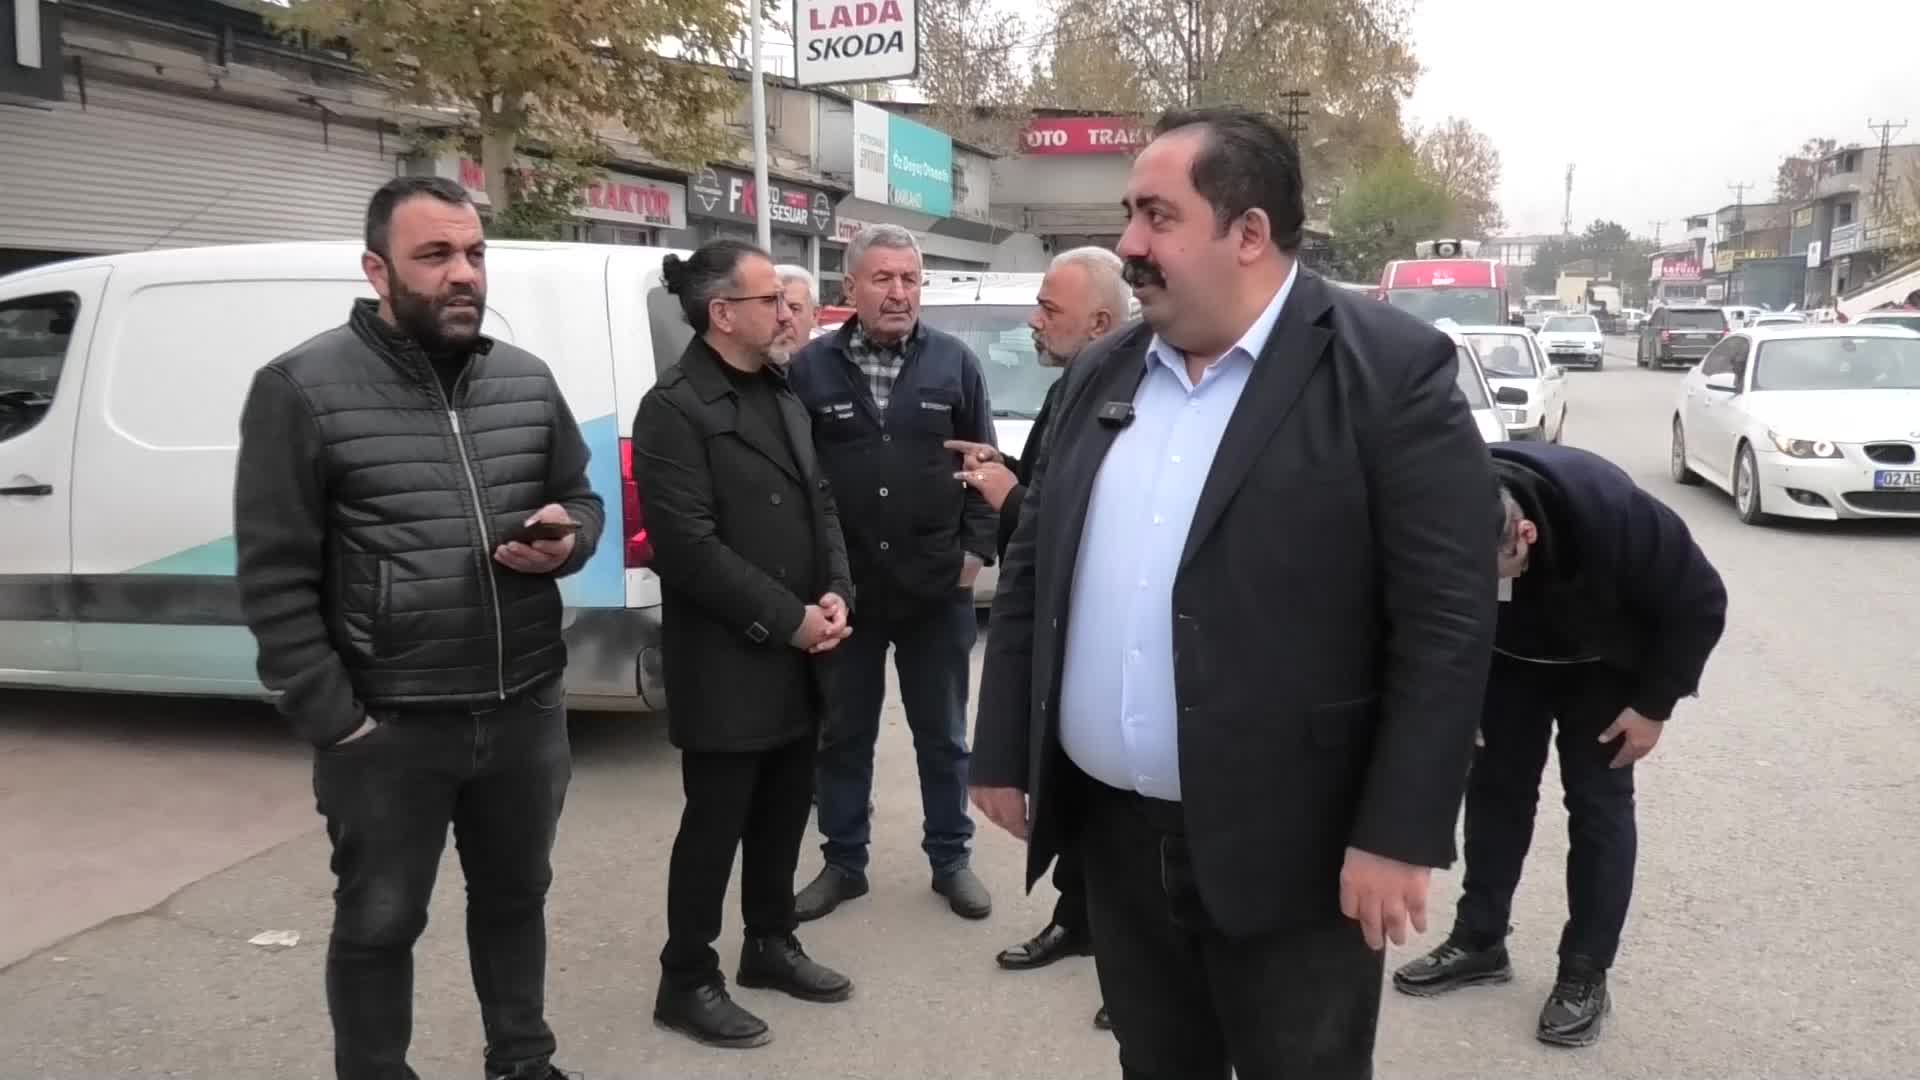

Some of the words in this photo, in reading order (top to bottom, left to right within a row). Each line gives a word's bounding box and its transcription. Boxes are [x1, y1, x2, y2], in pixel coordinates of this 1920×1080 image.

[809, 0, 904, 30] LADA
[806, 30, 904, 61] SKODA
[1027, 129, 1068, 147] OTO
[579, 180, 672, 217] RAKTÖR
[1884, 472, 1901, 486] 02
